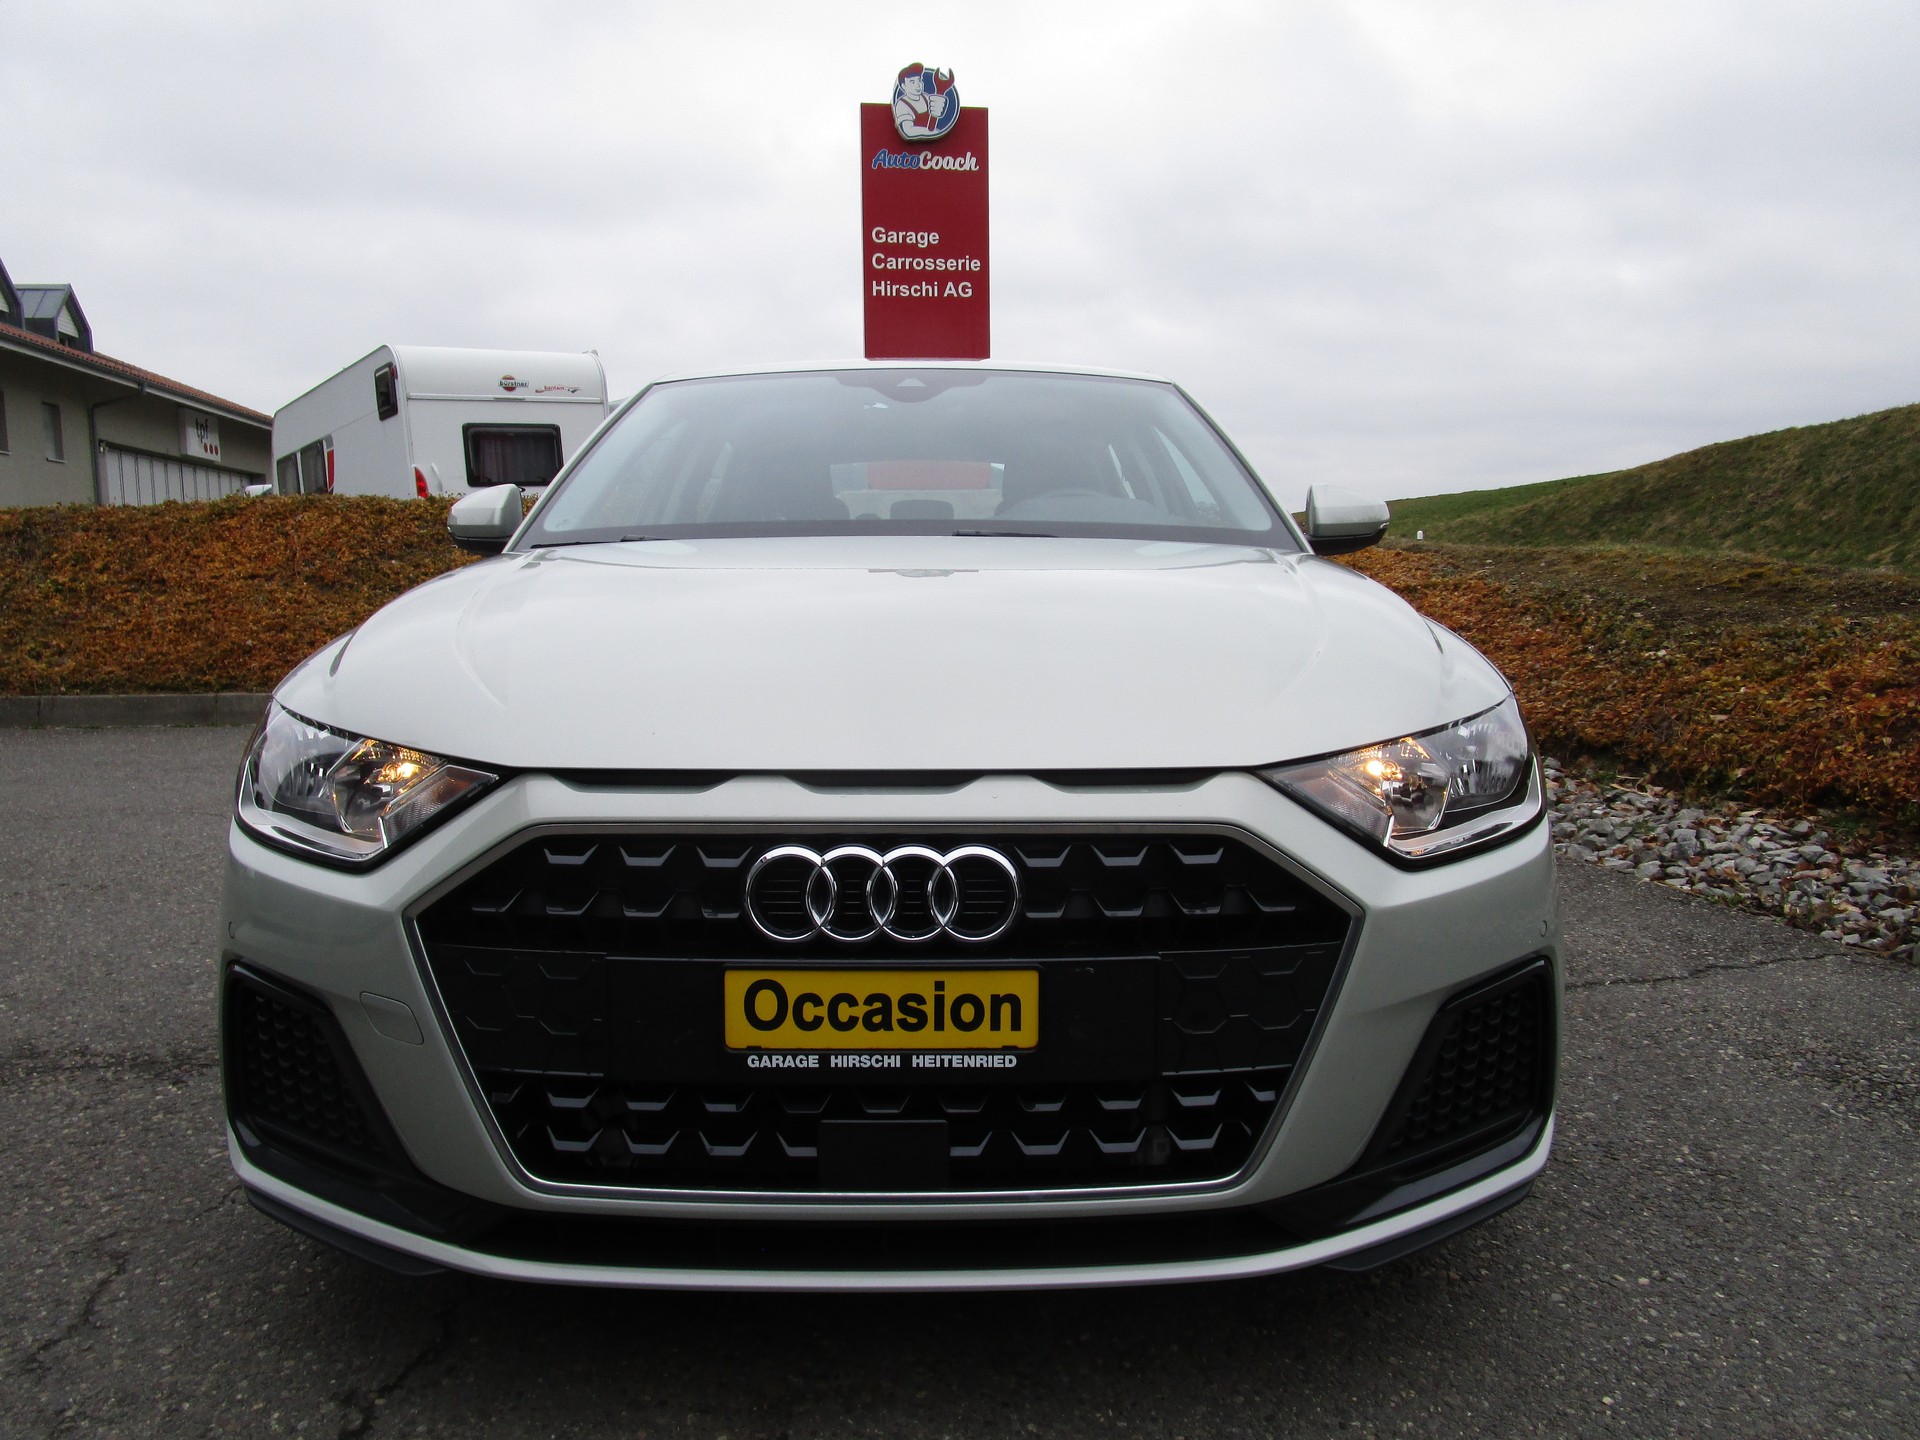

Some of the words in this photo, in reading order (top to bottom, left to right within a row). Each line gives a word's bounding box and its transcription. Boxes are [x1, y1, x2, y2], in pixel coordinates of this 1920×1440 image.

[871, 227, 940, 248] Garage
[871, 253, 981, 272] Carrosserie
[872, 281, 938, 297] Hirschi
[943, 281, 973, 298] AG
[744, 979, 1022, 1032] Occasion
[747, 1055, 819, 1068] GARAGE
[830, 1055, 901, 1068] HIRSCHI
[912, 1055, 1017, 1068] HEITENRIED
